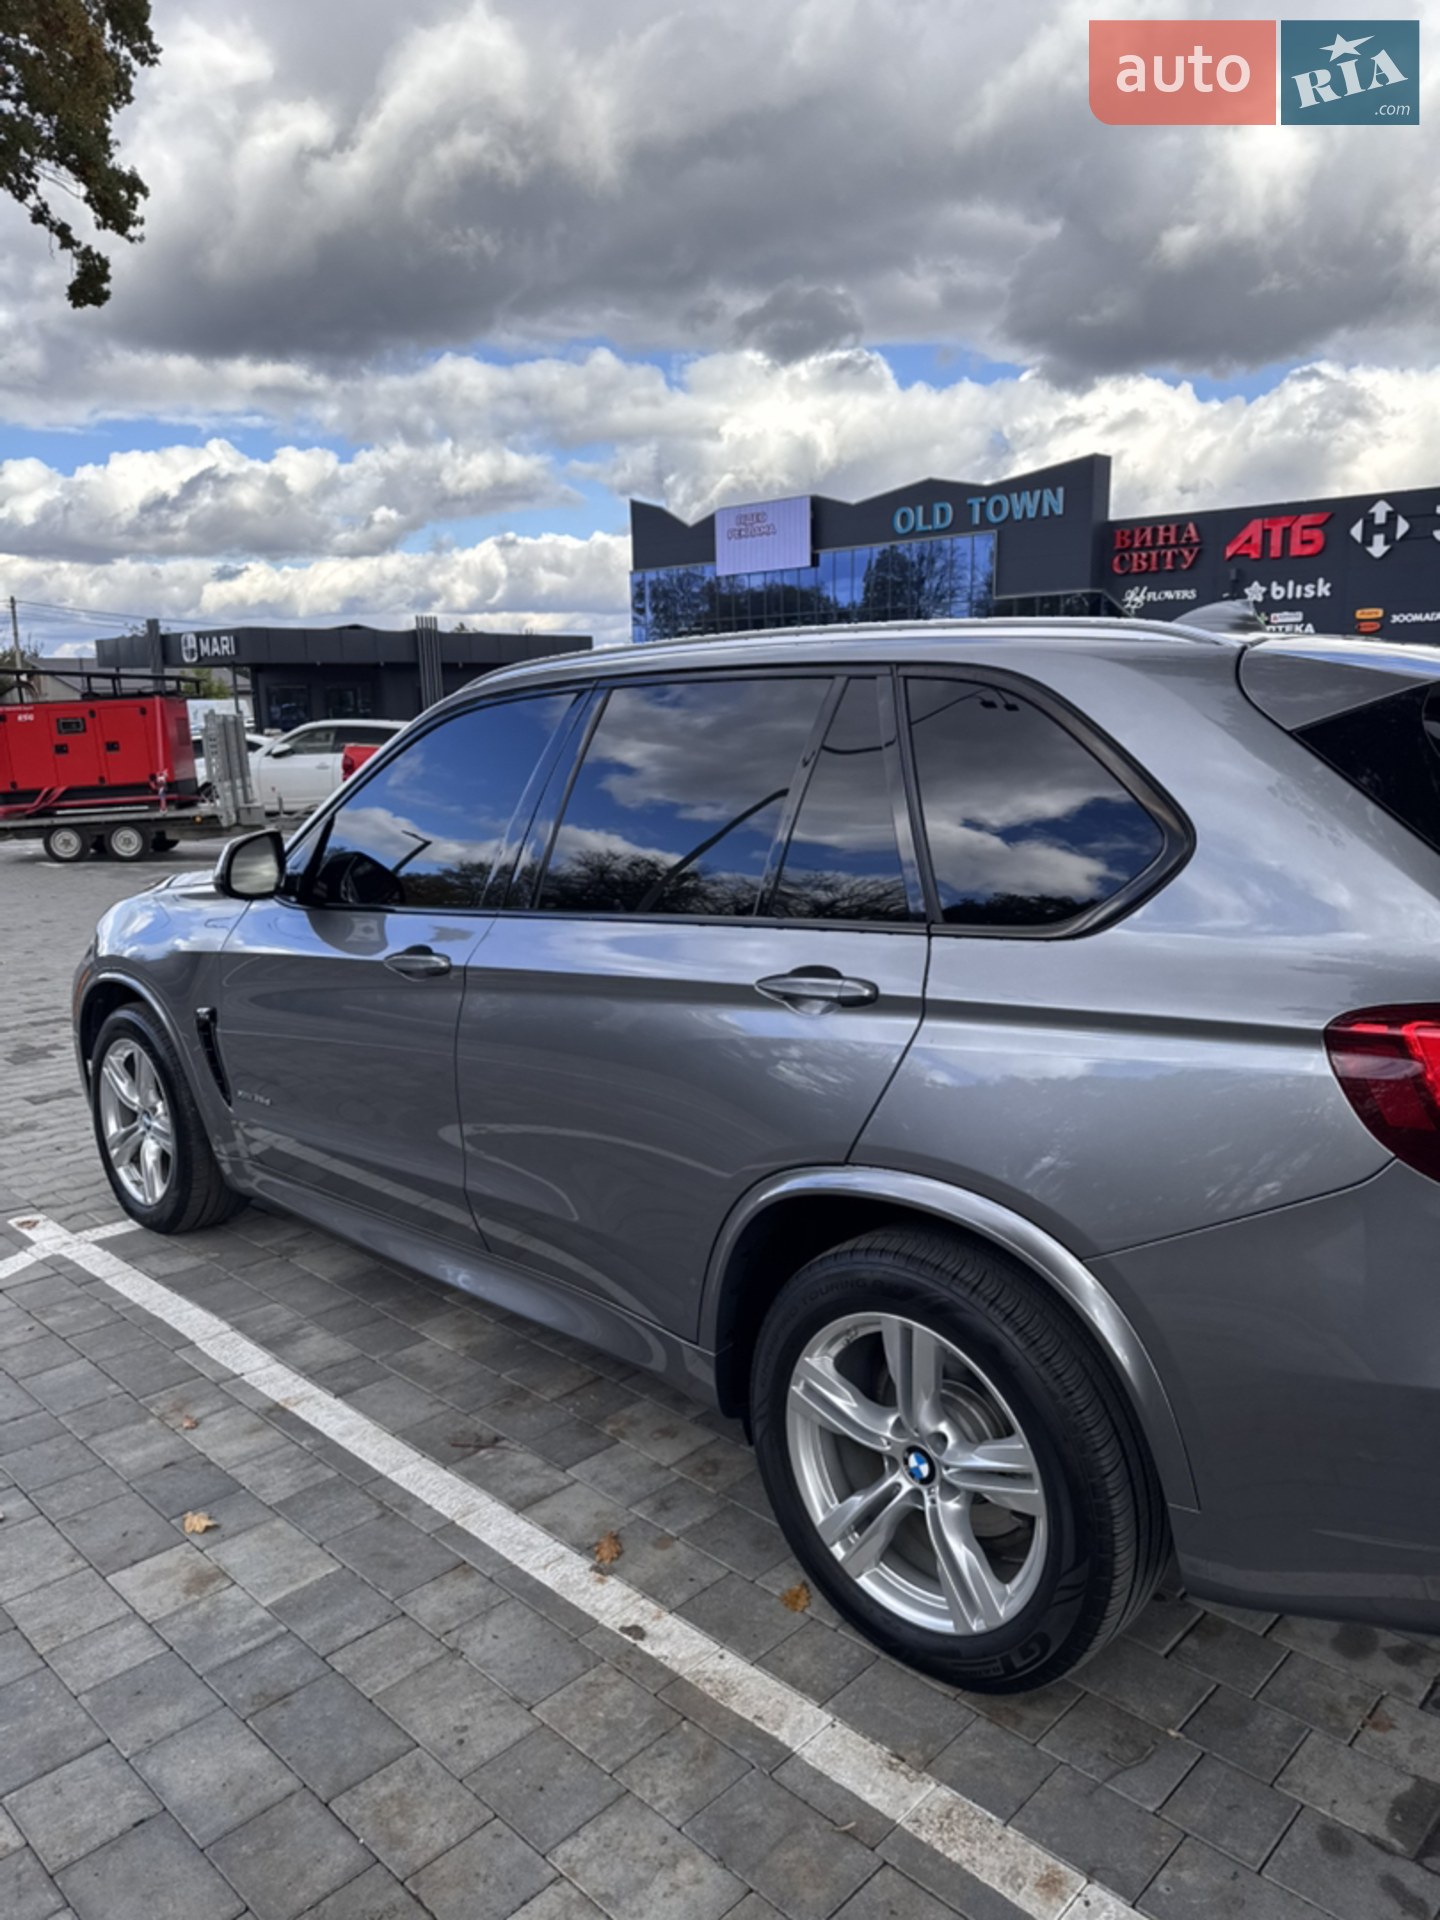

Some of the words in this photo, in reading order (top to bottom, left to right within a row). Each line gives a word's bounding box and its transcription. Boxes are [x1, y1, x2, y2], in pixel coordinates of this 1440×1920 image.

[892, 502, 953, 534] OLD
[967, 487, 1064, 525] TOWN
[1113, 522, 1201, 550] ВИНА
[1224, 512, 1334, 561] АТБ
[1112, 547, 1201, 575] СВІТУ
[1146, 589, 1197, 602] FLOWERS
[1270, 577, 1332, 600] blisk
[1266, 622, 1316, 634] ПТЕКА
[199, 635, 236, 657] MARI
